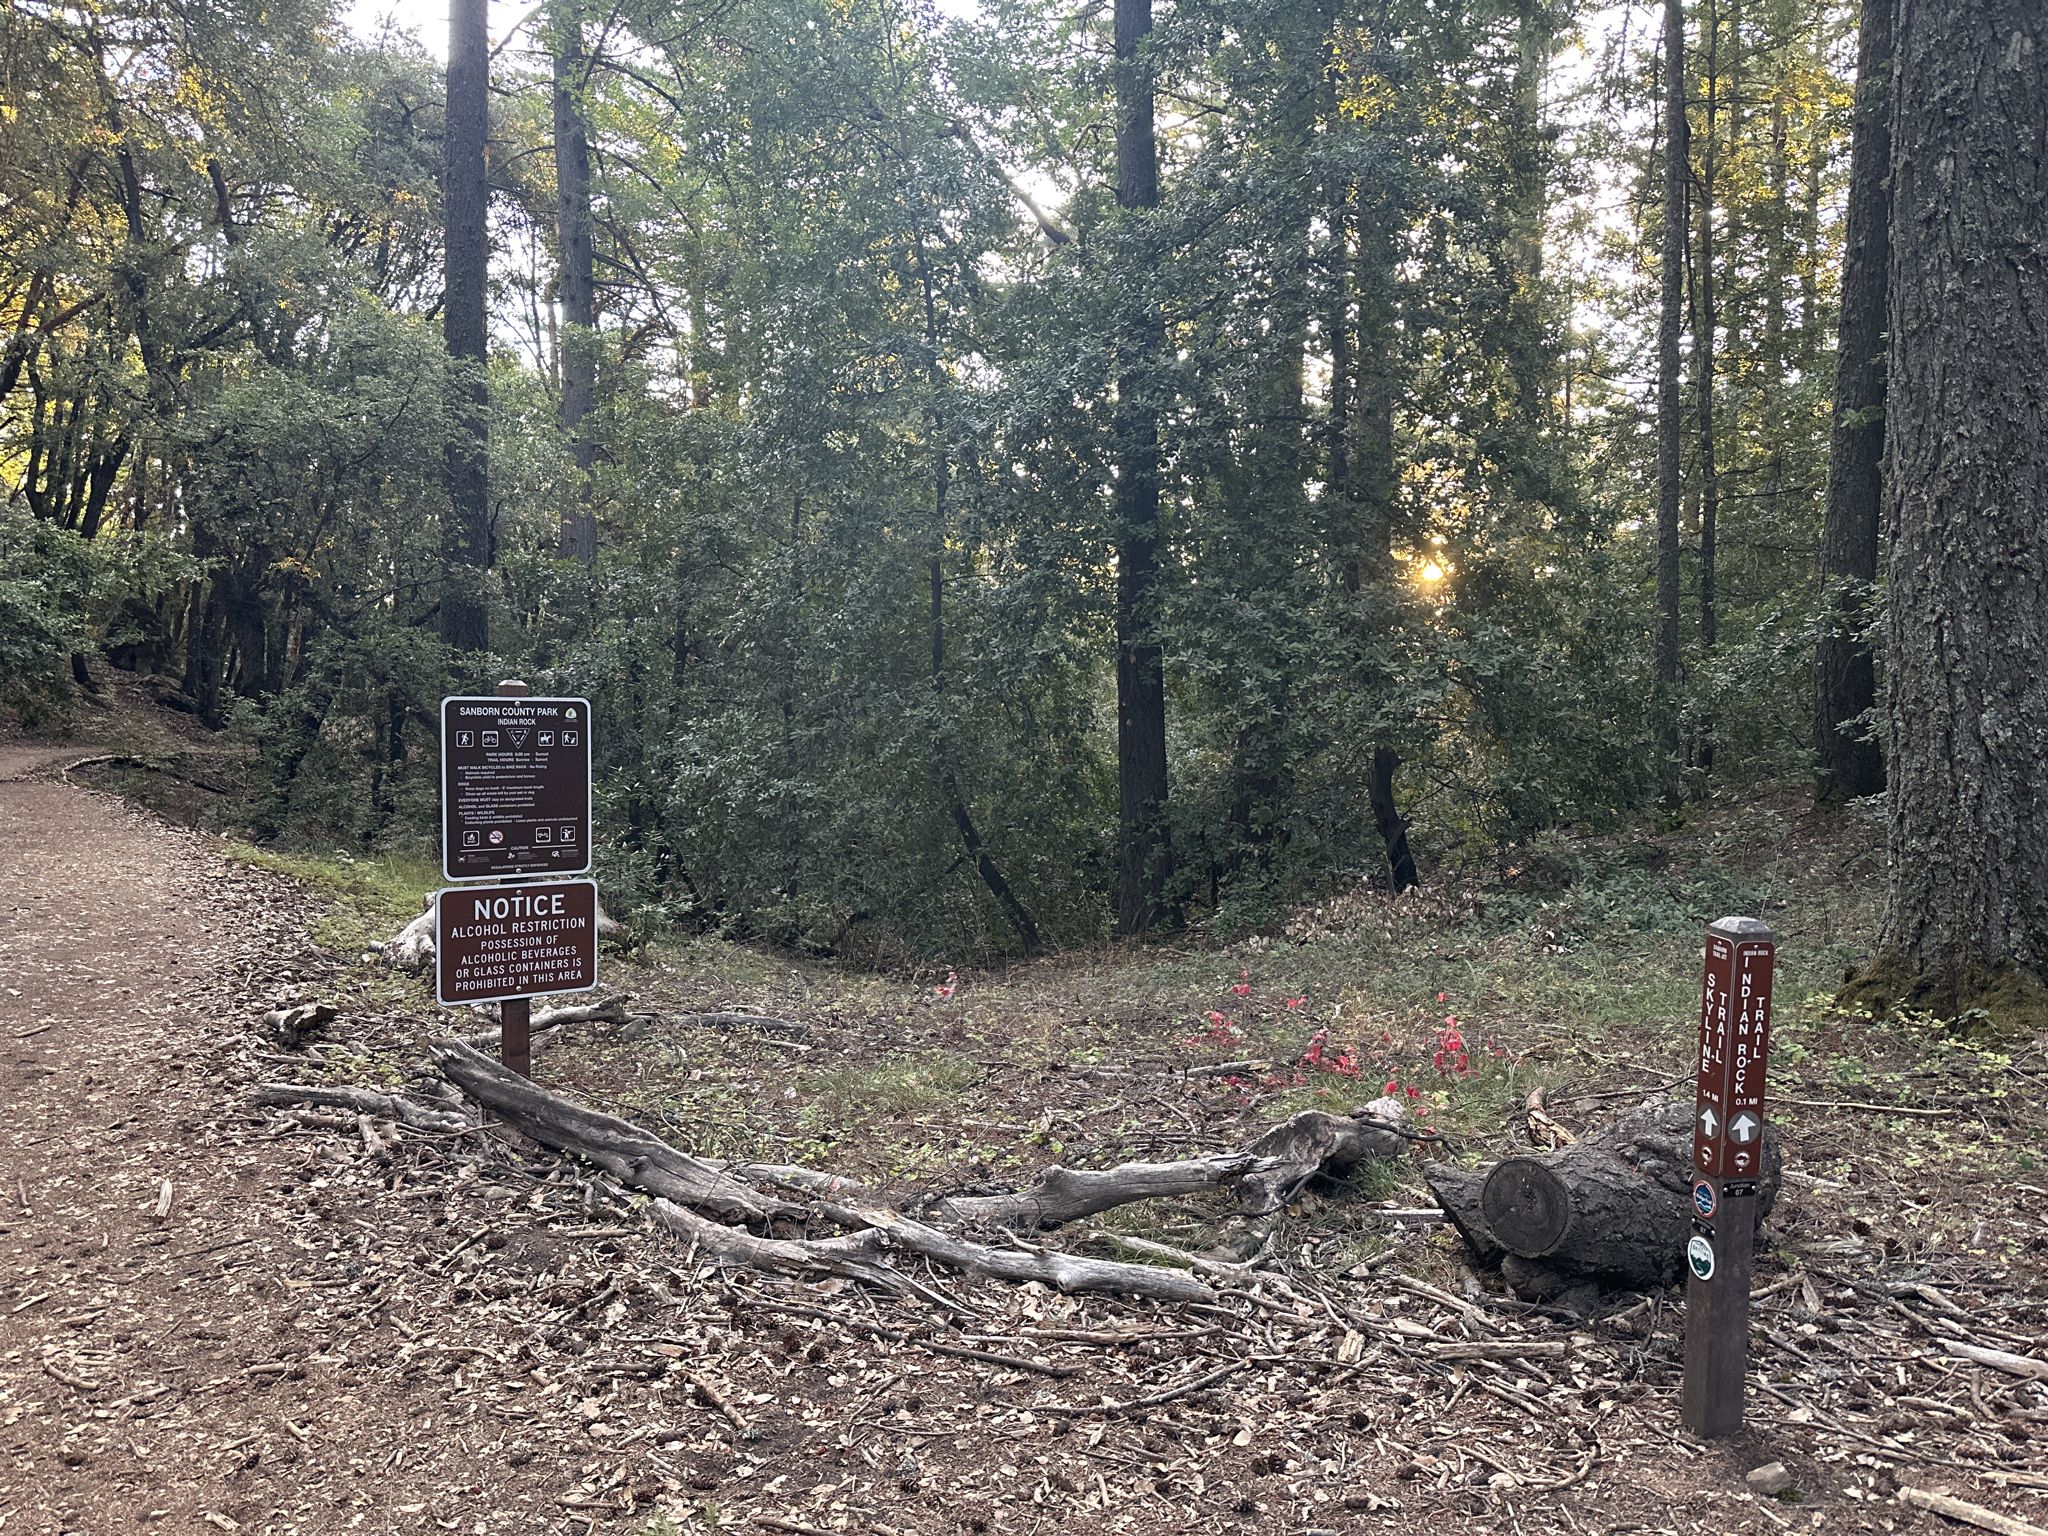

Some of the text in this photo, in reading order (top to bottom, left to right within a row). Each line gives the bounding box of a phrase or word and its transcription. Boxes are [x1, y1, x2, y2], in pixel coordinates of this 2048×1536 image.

[460, 707, 558, 716] SANBORN COUNTY PARK
[498, 718, 536, 726] INDIAN ROCK
[475, 894, 565, 921] NOTICE
[451, 917, 585, 939] ALCOHOL RESTRICTION
[481, 935, 558, 951] POSSESSION OF
[461, 945, 577, 966] ALCOHOLIC BEVERAGES
[456, 958, 582, 979] OR GLASS CONTAINERS IS
[455, 970, 583, 992] PROHIBITED IN THIS AREA
[1702, 973, 1716, 1073] SKYLINE
[1715, 992, 1727, 1065] TRAIL
[1734, 956, 1752, 1095] INDIAN ROCK
[1753, 997, 1766, 1059] TRAIL
[1711, 1093, 1719, 1103] MI
[1735, 1097, 1758, 1106] 0.1 MI
